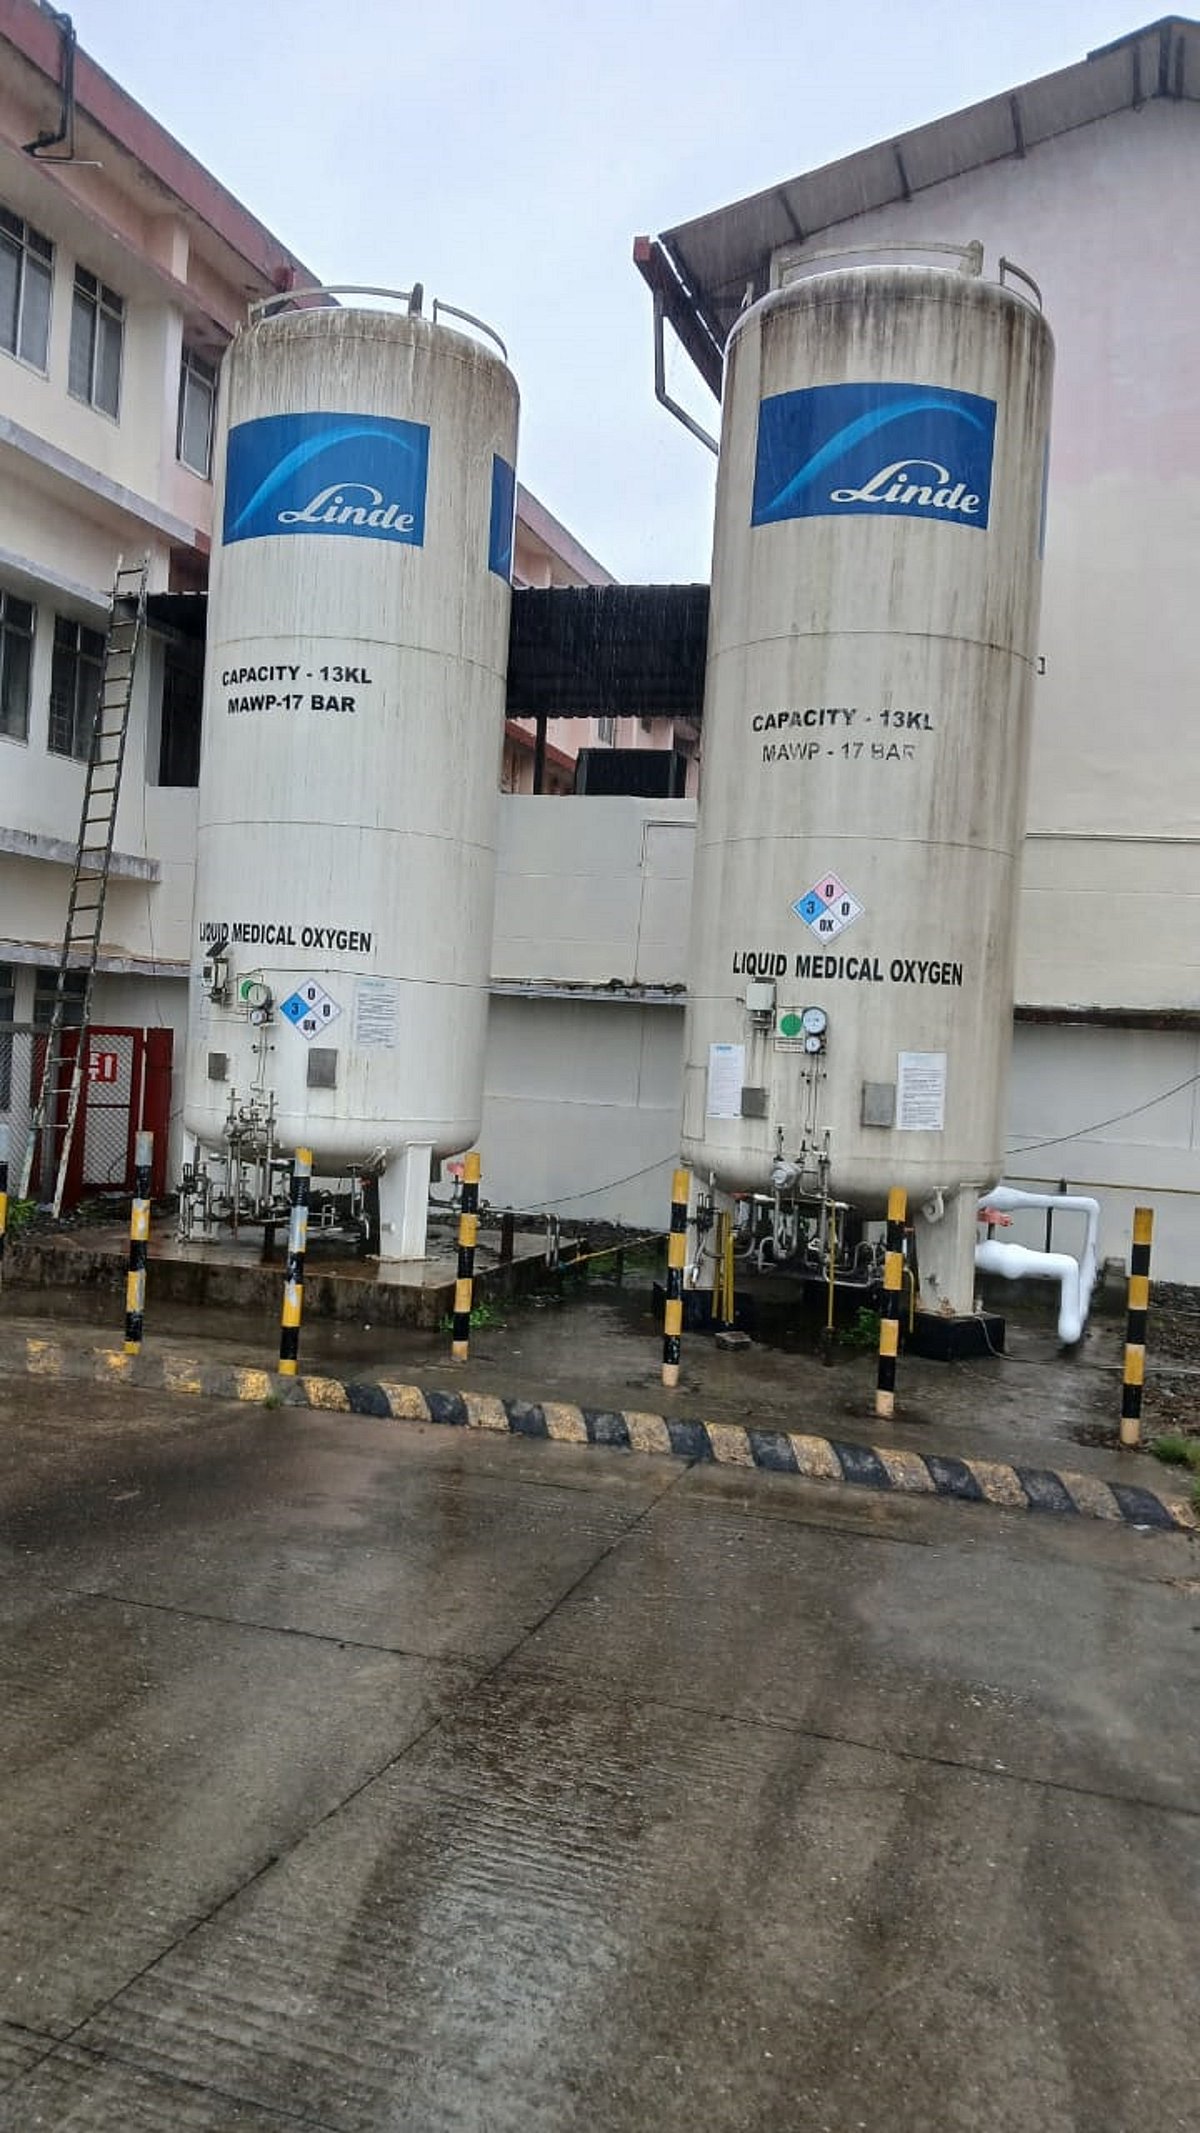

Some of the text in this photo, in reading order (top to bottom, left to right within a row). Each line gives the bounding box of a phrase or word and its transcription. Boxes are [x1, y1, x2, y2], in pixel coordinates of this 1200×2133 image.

[830, 459, 981, 514] Linde
[278, 483, 415, 532] Linde
[222, 665, 300, 686] CAPACITY
[319, 666, 372, 684] 13KL
[227, 694, 356, 714] MAWP-17 BAR
[751, 708, 857, 732] CAPACITY
[879, 709, 934, 731] 13KL
[762, 741, 820, 763] MAWP
[840, 742, 864, 760] 17
[825, 883, 834, 898] 0
[806, 901, 815, 914] 3
[841, 902, 850, 916] 0
[231, 923, 296, 946] MEDICAL
[301, 927, 372, 952] OXYGEN
[733, 951, 963, 986] LIQUID MEDICAL OXYGEN
[290, 1002, 299, 1015] 3
